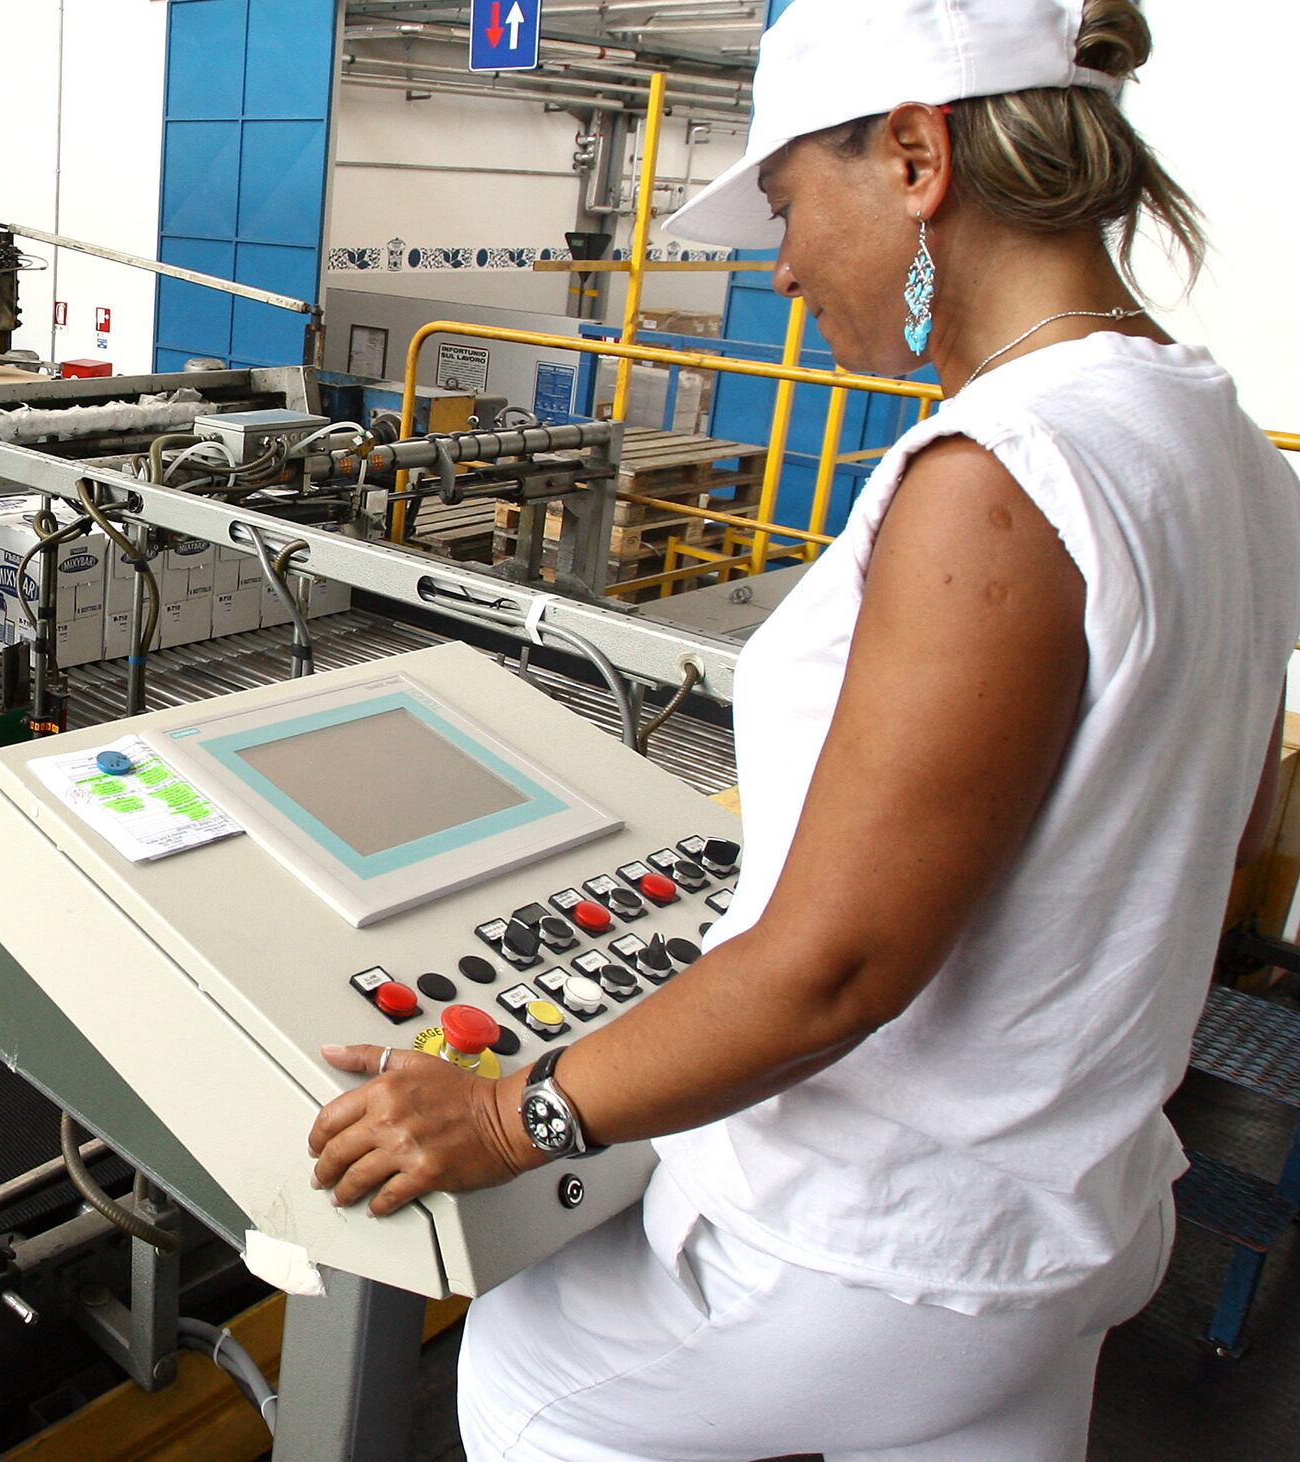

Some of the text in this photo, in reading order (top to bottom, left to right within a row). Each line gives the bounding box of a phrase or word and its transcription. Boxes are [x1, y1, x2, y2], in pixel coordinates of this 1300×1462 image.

[441, 346, 486, 358] INFORTUNIO
[441, 352, 486, 363] SUL LAVORO
[414, 1027, 444, 1051] MERGE
